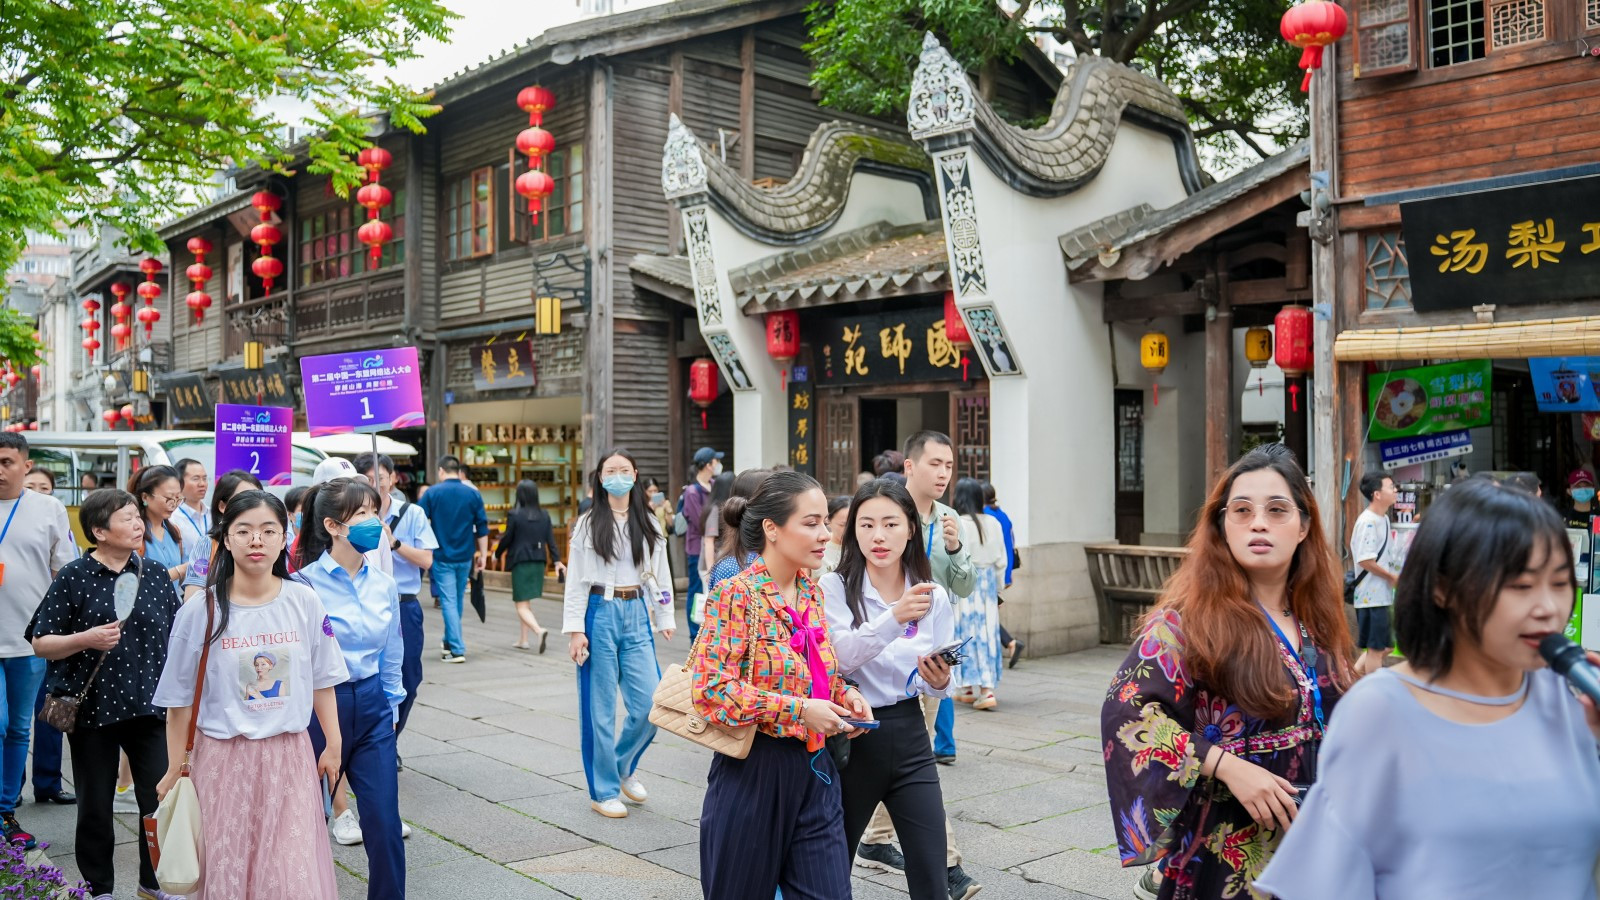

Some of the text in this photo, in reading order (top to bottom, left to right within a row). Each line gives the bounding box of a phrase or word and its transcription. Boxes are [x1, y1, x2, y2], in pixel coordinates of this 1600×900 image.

[360, 396, 374, 420] 1
[249, 451, 260, 474] 2
[1396, 511, 1413, 523] 10
